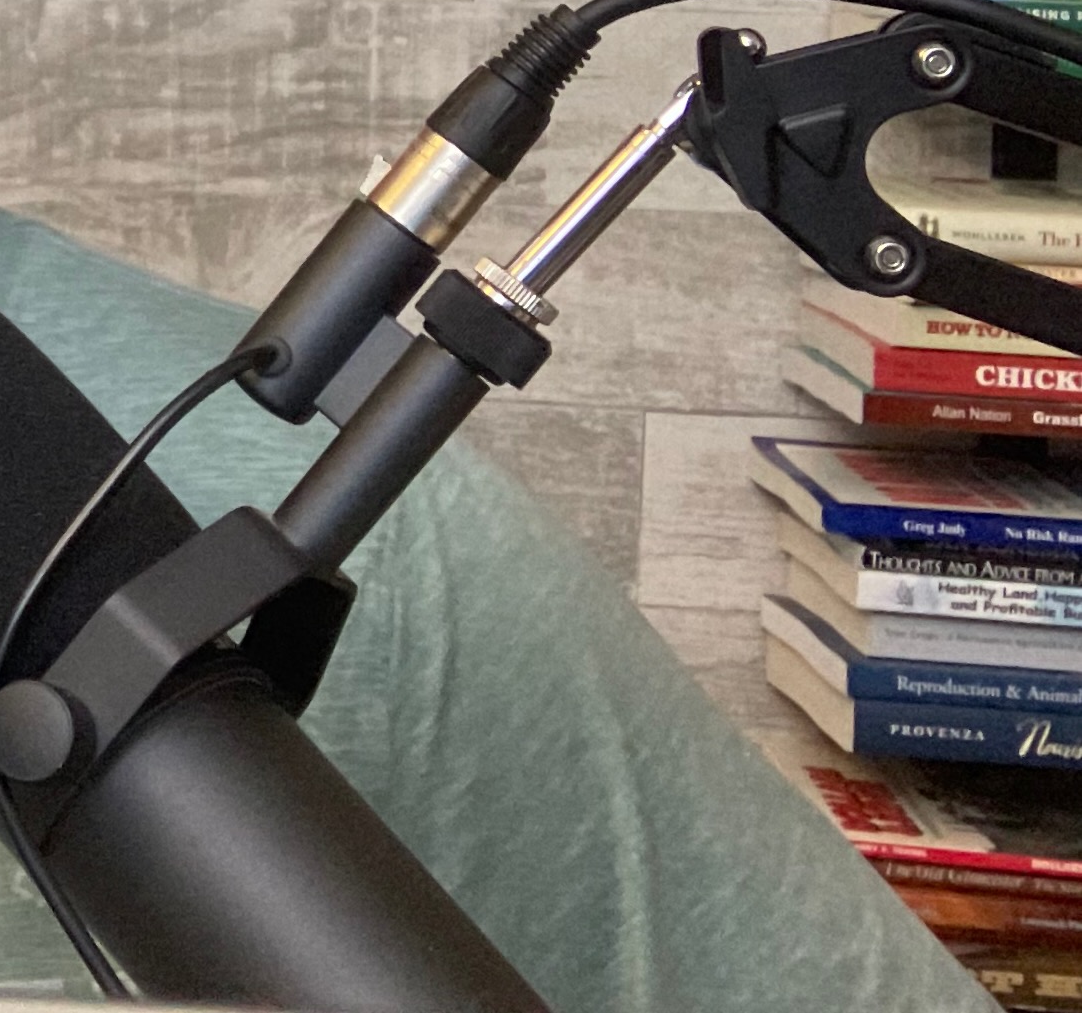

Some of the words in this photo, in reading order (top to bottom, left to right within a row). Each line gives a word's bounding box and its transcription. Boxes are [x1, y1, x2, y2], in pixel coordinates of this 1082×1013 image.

[1038, 230, 1071, 247] The
[926, 321, 973, 337] HOW
[975, 323, 1003, 338] TO
[932, 404, 966, 419] Allan
[969, 406, 1012, 423] Nation
[903, 520, 935, 535] Greg
[937, 521, 967, 537] Judy
[1005, 526, 1023, 539] No
[1026, 529, 1054, 542] Risk
[946, 561, 978, 578] AND
[980, 560, 1030, 582] ADVICE
[1034, 568, 1075, 585] FROM
[938, 581, 997, 601] Healthy
[950, 600, 978, 612] and
[984, 601, 1057, 618] Profitable
[897, 675, 1001, 697] Reproduction
[1006, 684, 1022, 700] &
[1027, 686, 1082, 704] Animal
[890, 724, 985, 741] PROVENZA
